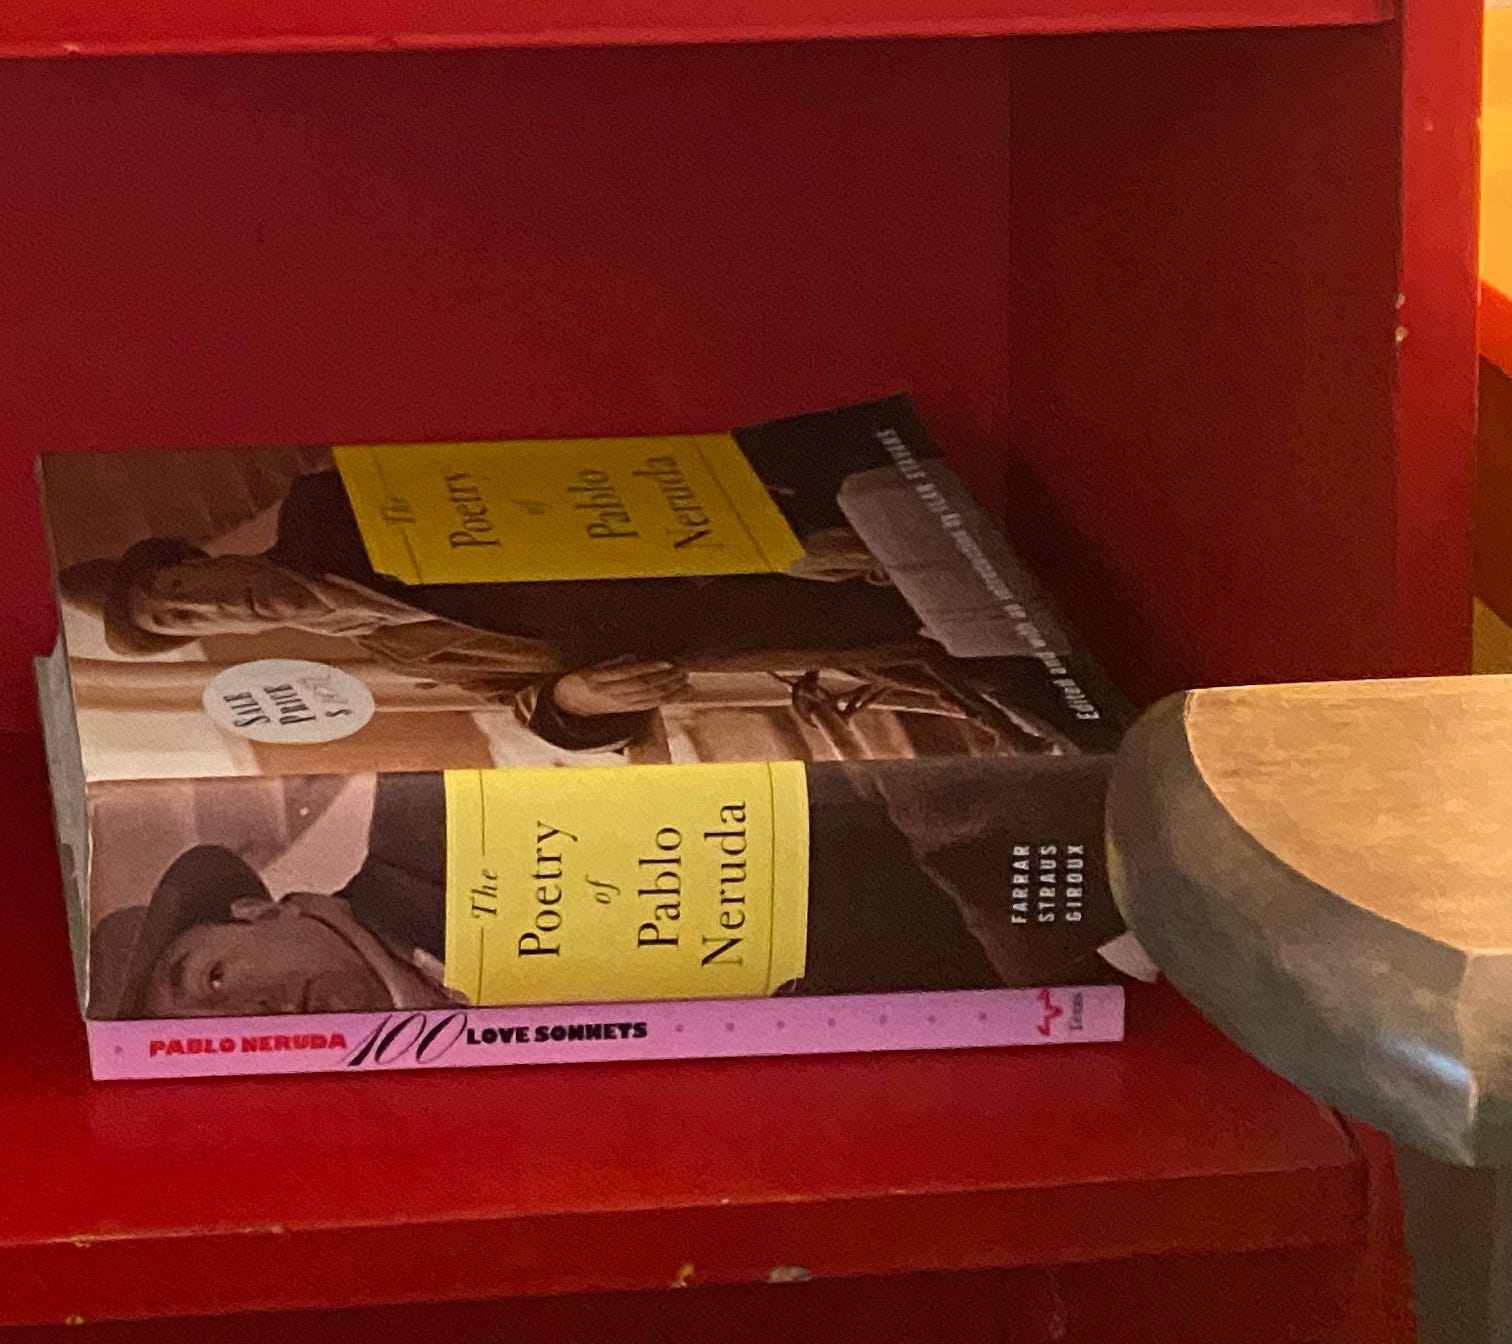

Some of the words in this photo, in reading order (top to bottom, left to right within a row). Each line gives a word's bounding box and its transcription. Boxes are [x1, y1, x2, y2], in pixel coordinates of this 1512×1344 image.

[470, 869, 499, 920] The
[517, 820, 577, 959] Poetry
[586, 879, 621, 905] of
[637, 825, 682, 950] Pablo
[701, 800, 748, 967] Neruda
[1011, 845, 1030, 924] FARRAR
[1039, 845, 1057, 922] STRAUS
[1066, 844, 1084, 922] GIROUX
